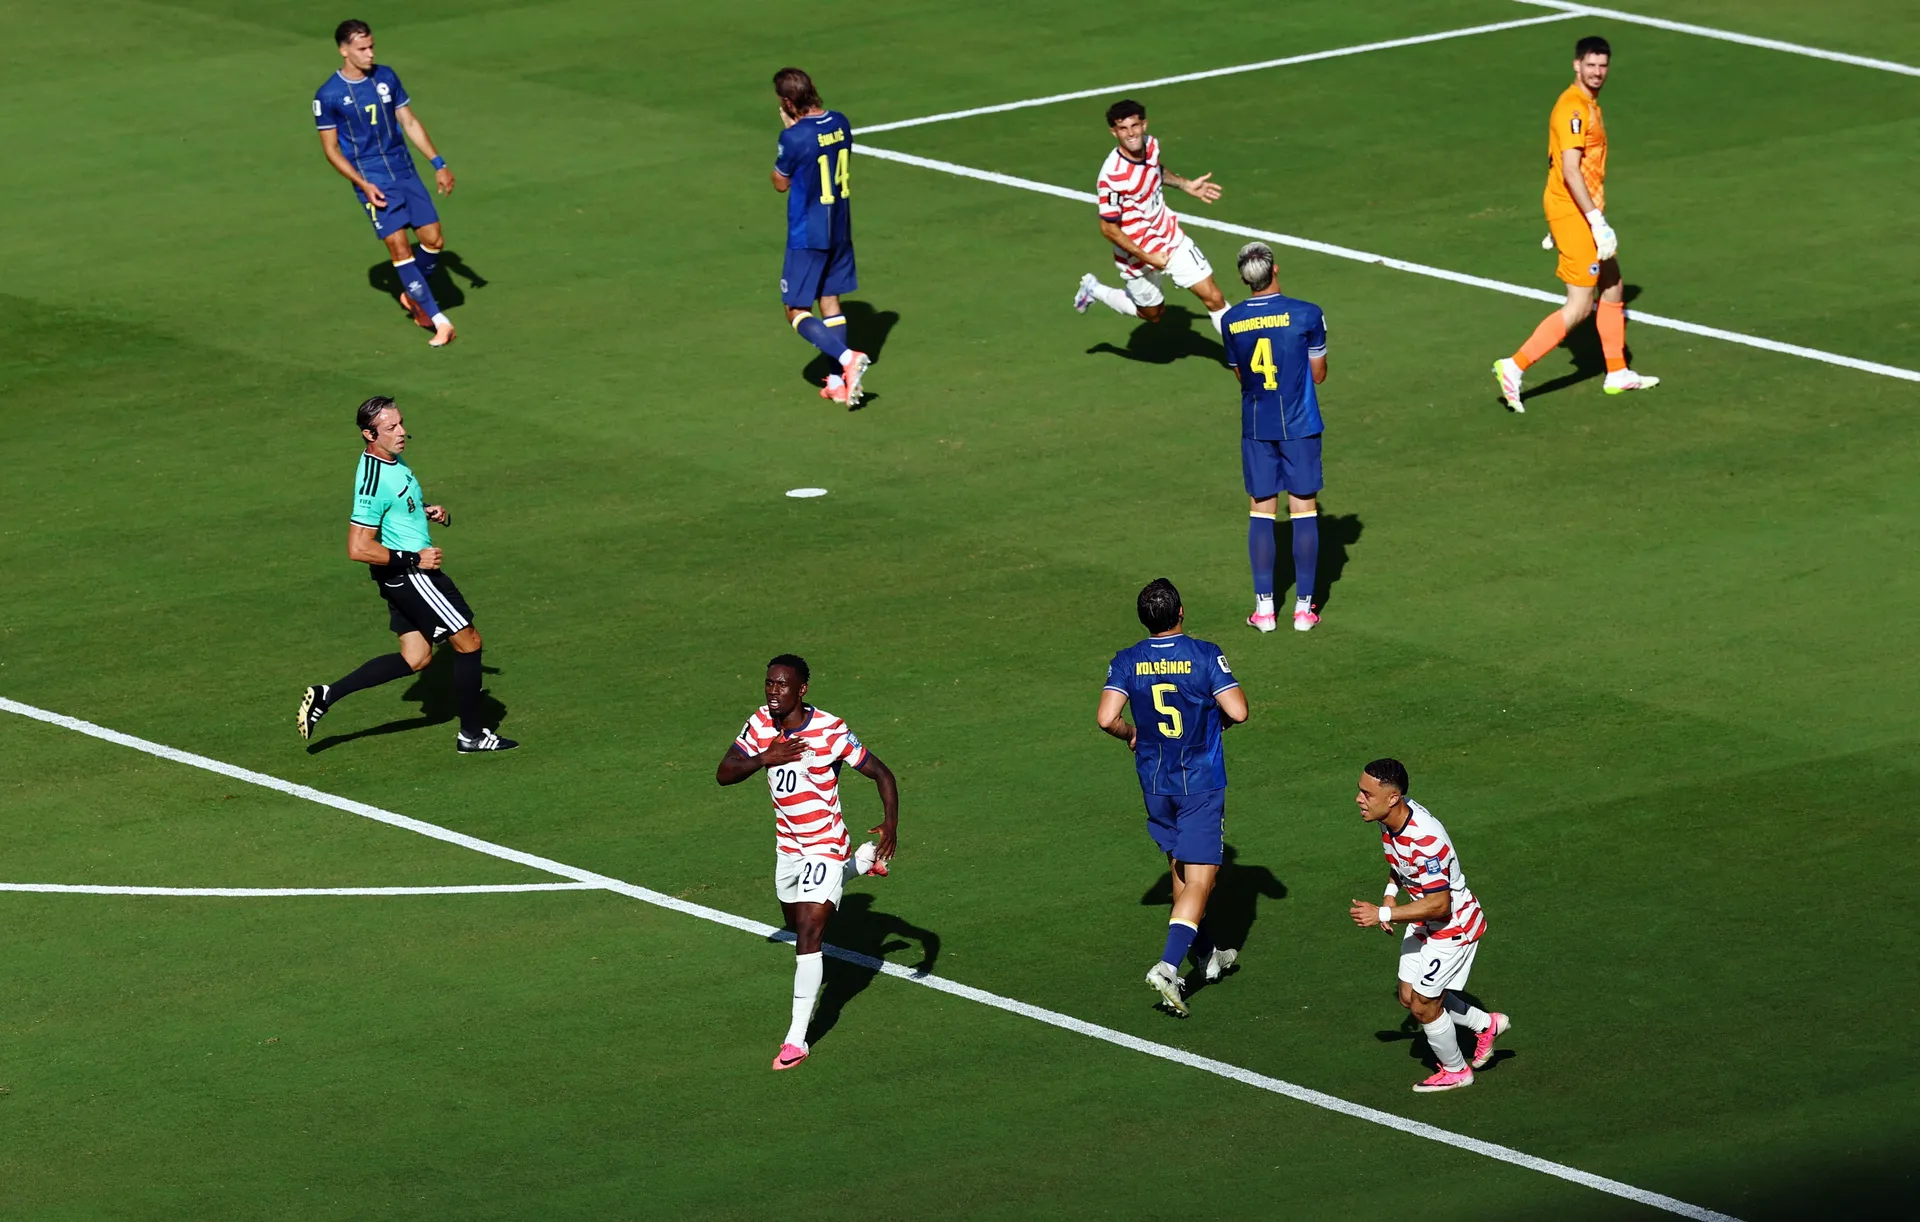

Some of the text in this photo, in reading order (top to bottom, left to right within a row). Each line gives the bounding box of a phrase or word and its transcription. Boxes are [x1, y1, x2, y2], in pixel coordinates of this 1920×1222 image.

[365, 103, 378, 125] 7
[817, 148, 850, 205] 14
[366, 202, 377, 221] 7
[1229, 312, 1290, 335] MUHAREMOVIĆ
[1250, 337, 1278, 391] 4
[1136, 658, 1192, 676] KOLAŠINAC
[1151, 683, 1184, 740] 5
[776, 768, 797, 793] 20
[802, 862, 827, 886] 20
[1424, 958, 1441, 982] 2
